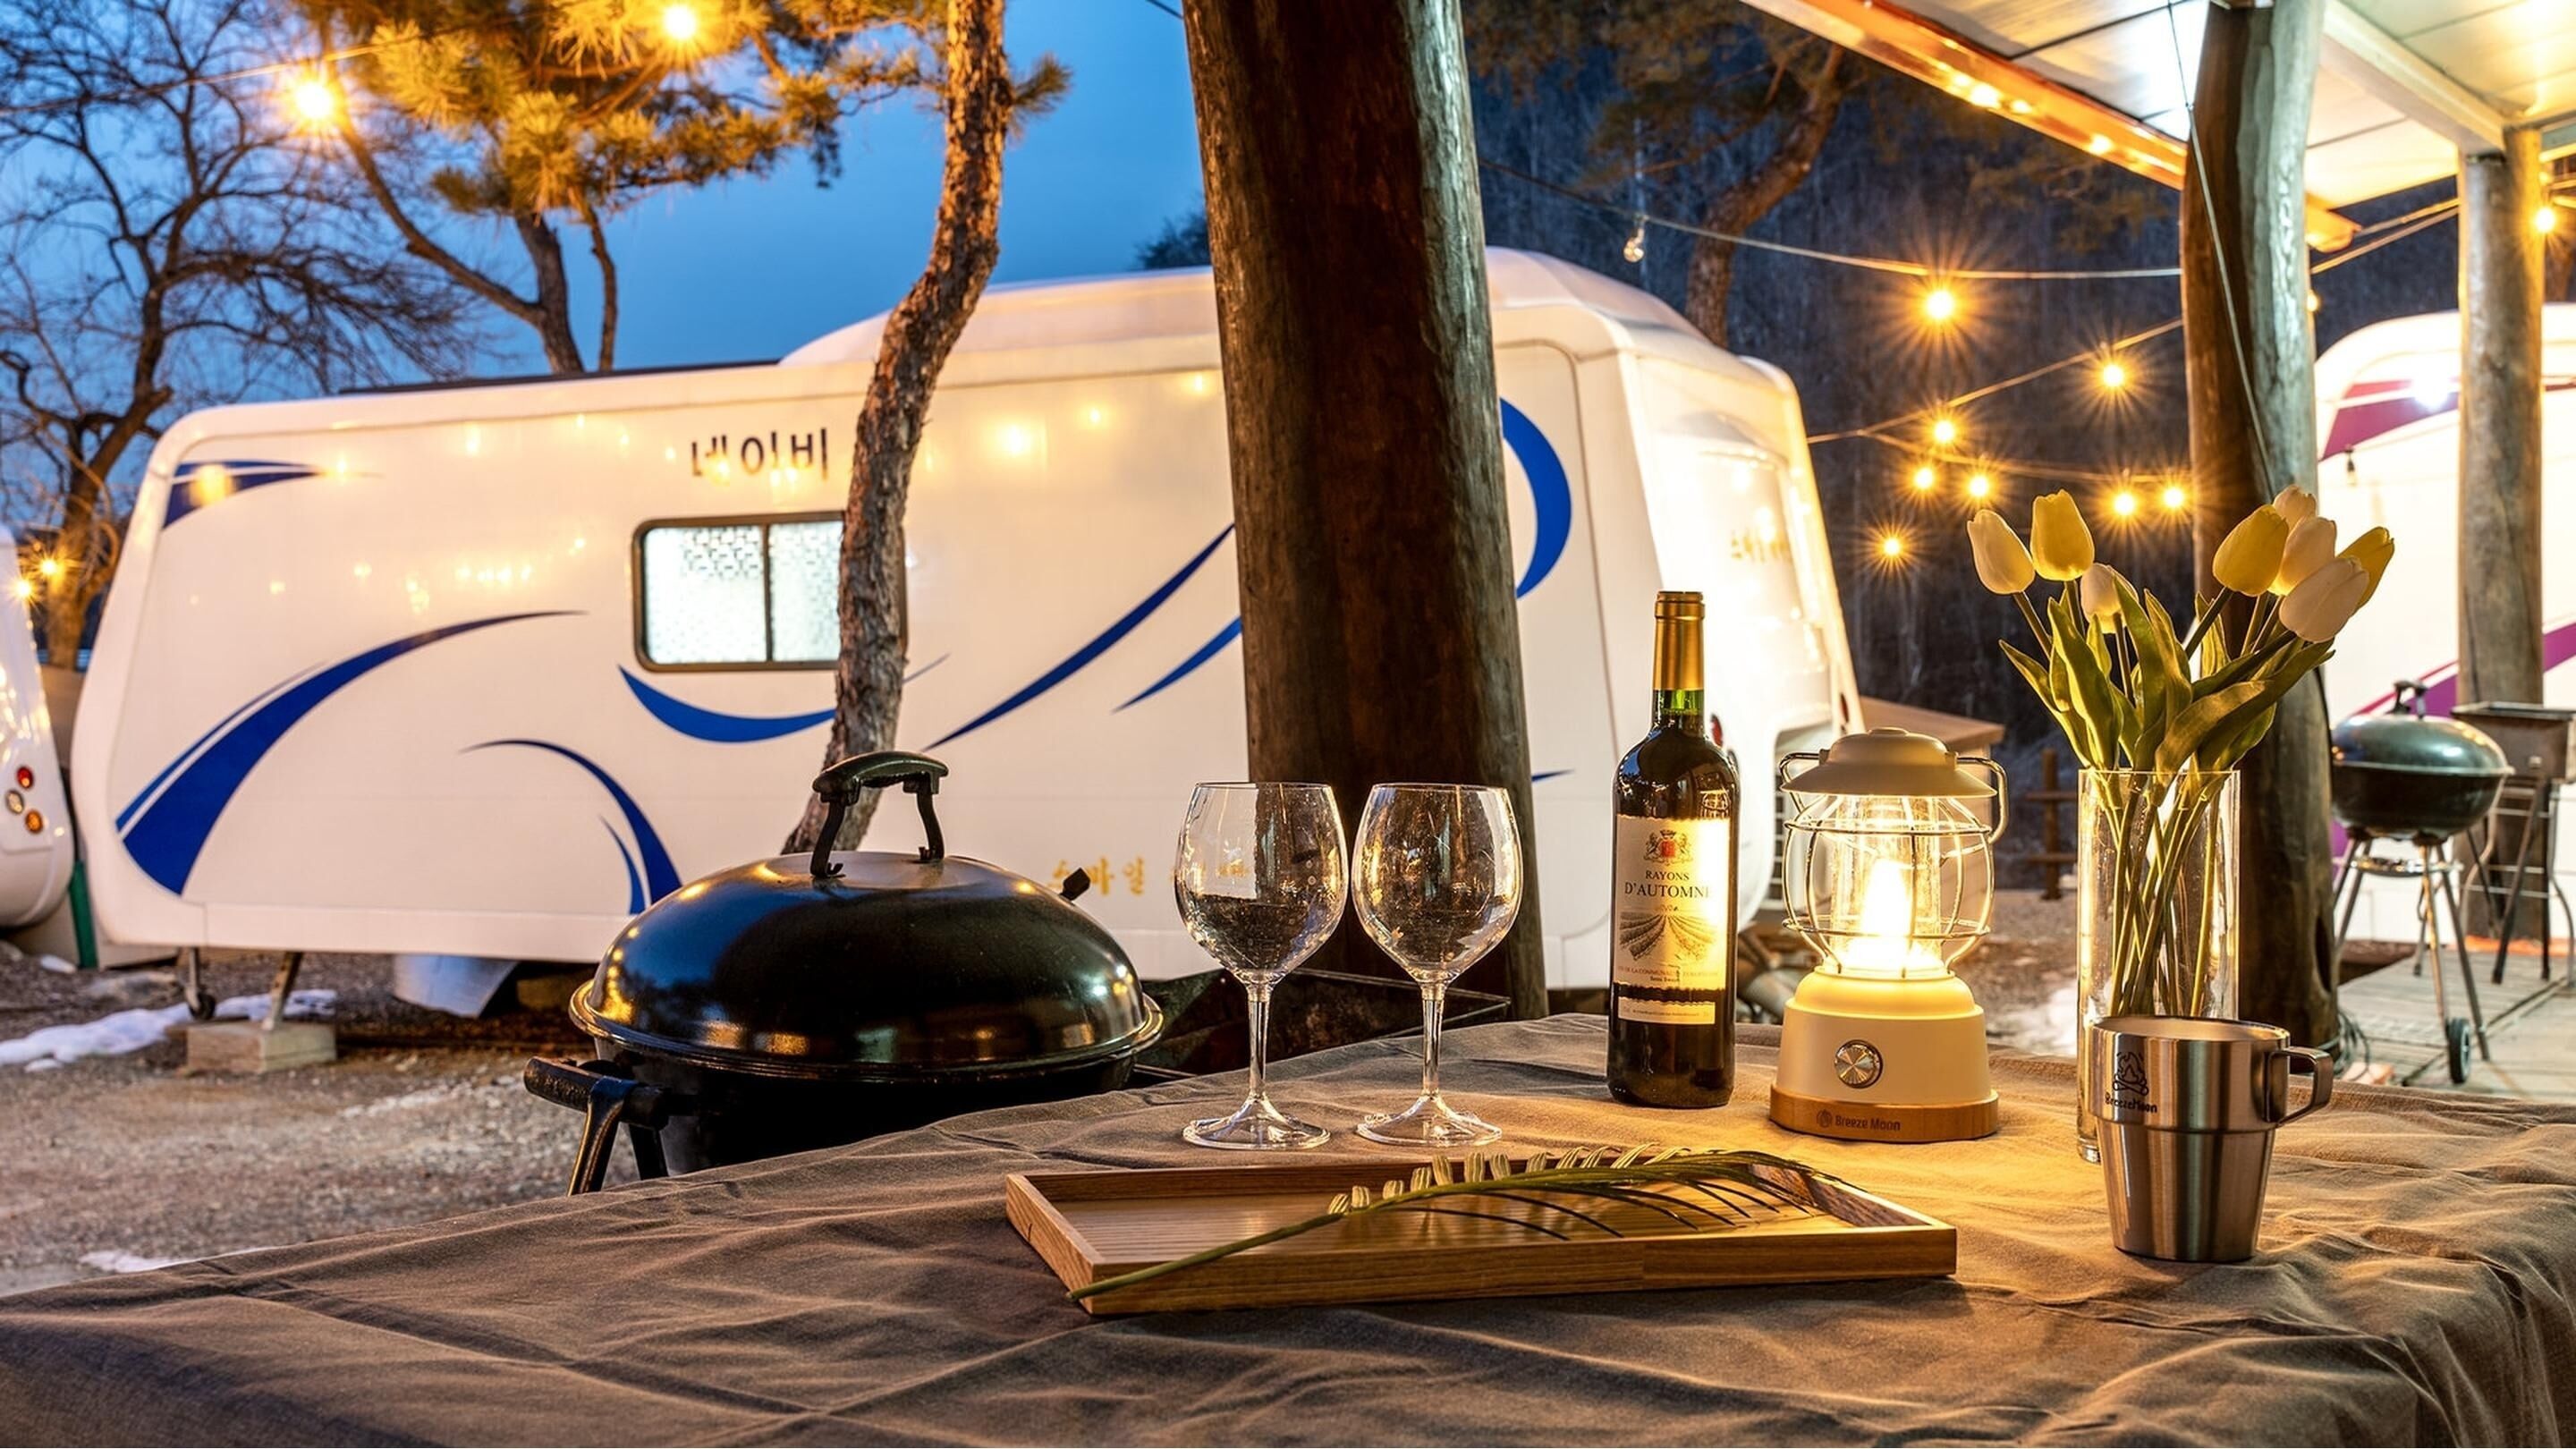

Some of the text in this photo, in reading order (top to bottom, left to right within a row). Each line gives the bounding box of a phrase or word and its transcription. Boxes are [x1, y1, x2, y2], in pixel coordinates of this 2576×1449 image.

[691, 428, 828, 481] 네이비
[1645, 869, 1690, 881] RAYONS
[1835, 1114, 1901, 1131] Breeze Moon
